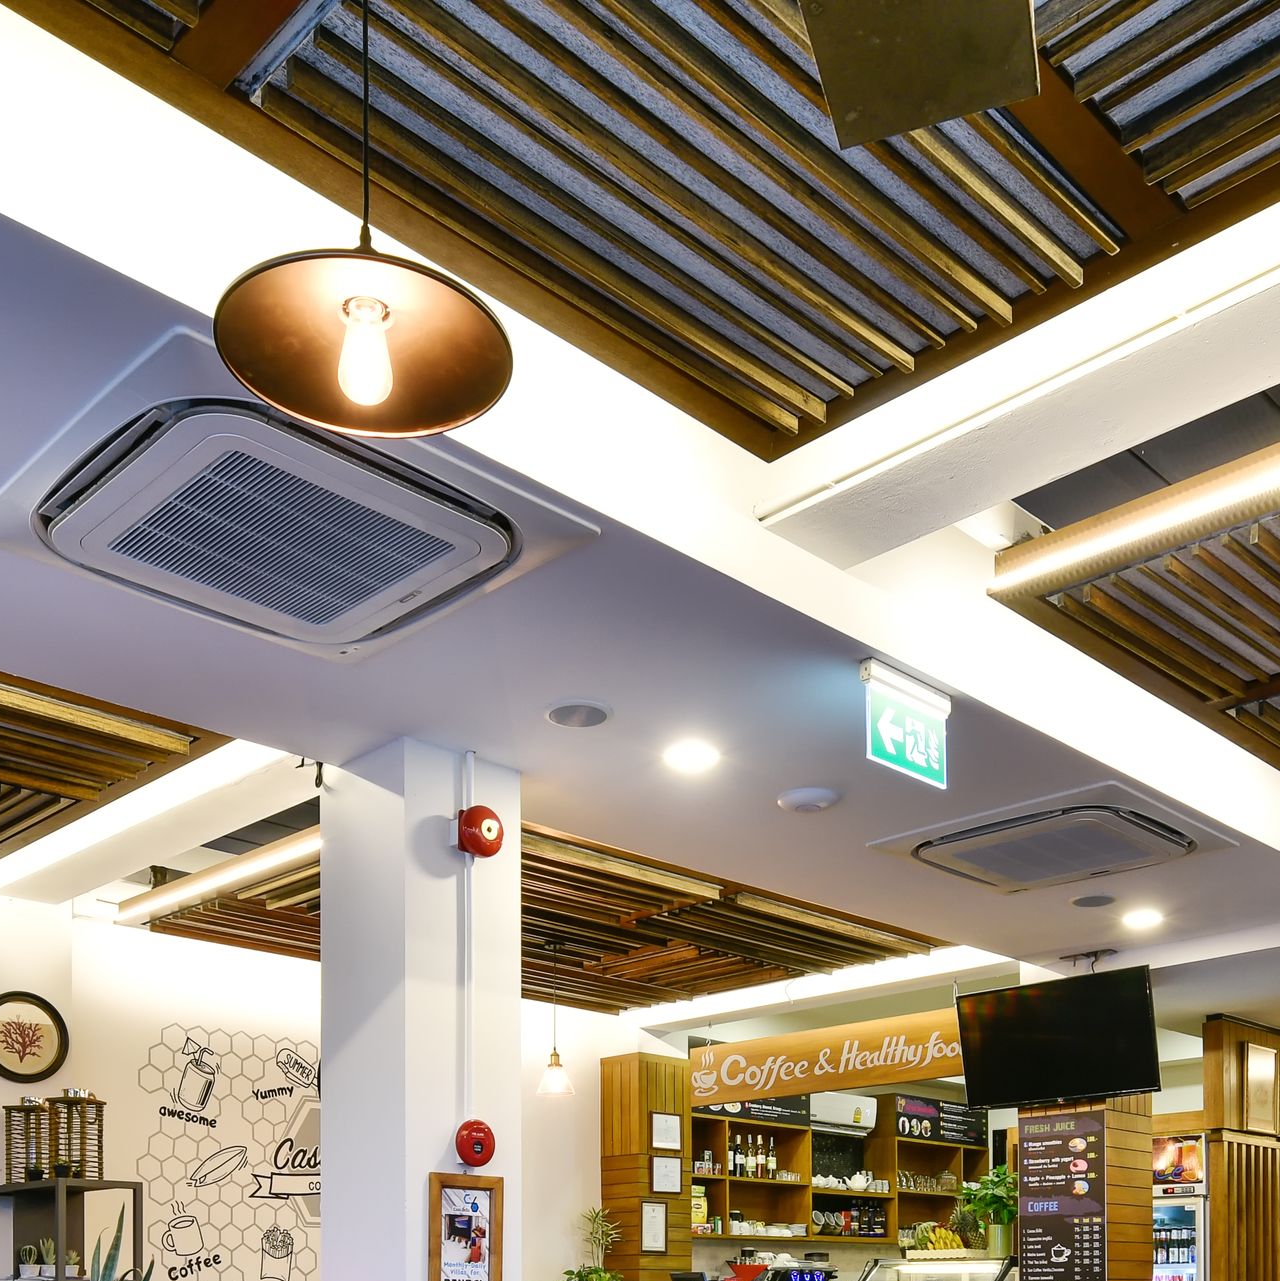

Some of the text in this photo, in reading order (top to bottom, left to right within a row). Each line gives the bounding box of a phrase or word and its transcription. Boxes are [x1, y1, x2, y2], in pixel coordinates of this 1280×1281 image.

[283, 1053, 313, 1083] SUMMER
[720, 1030, 962, 1091] Coffee & Healthy foo
[252, 1085, 294, 1101] Yummy
[159, 1105, 218, 1129] awesome
[1024, 1121, 1076, 1134] FRESH JUICE
[1027, 1201, 1059, 1213] COFFEE
[167, 1253, 222, 1281] Coffee
